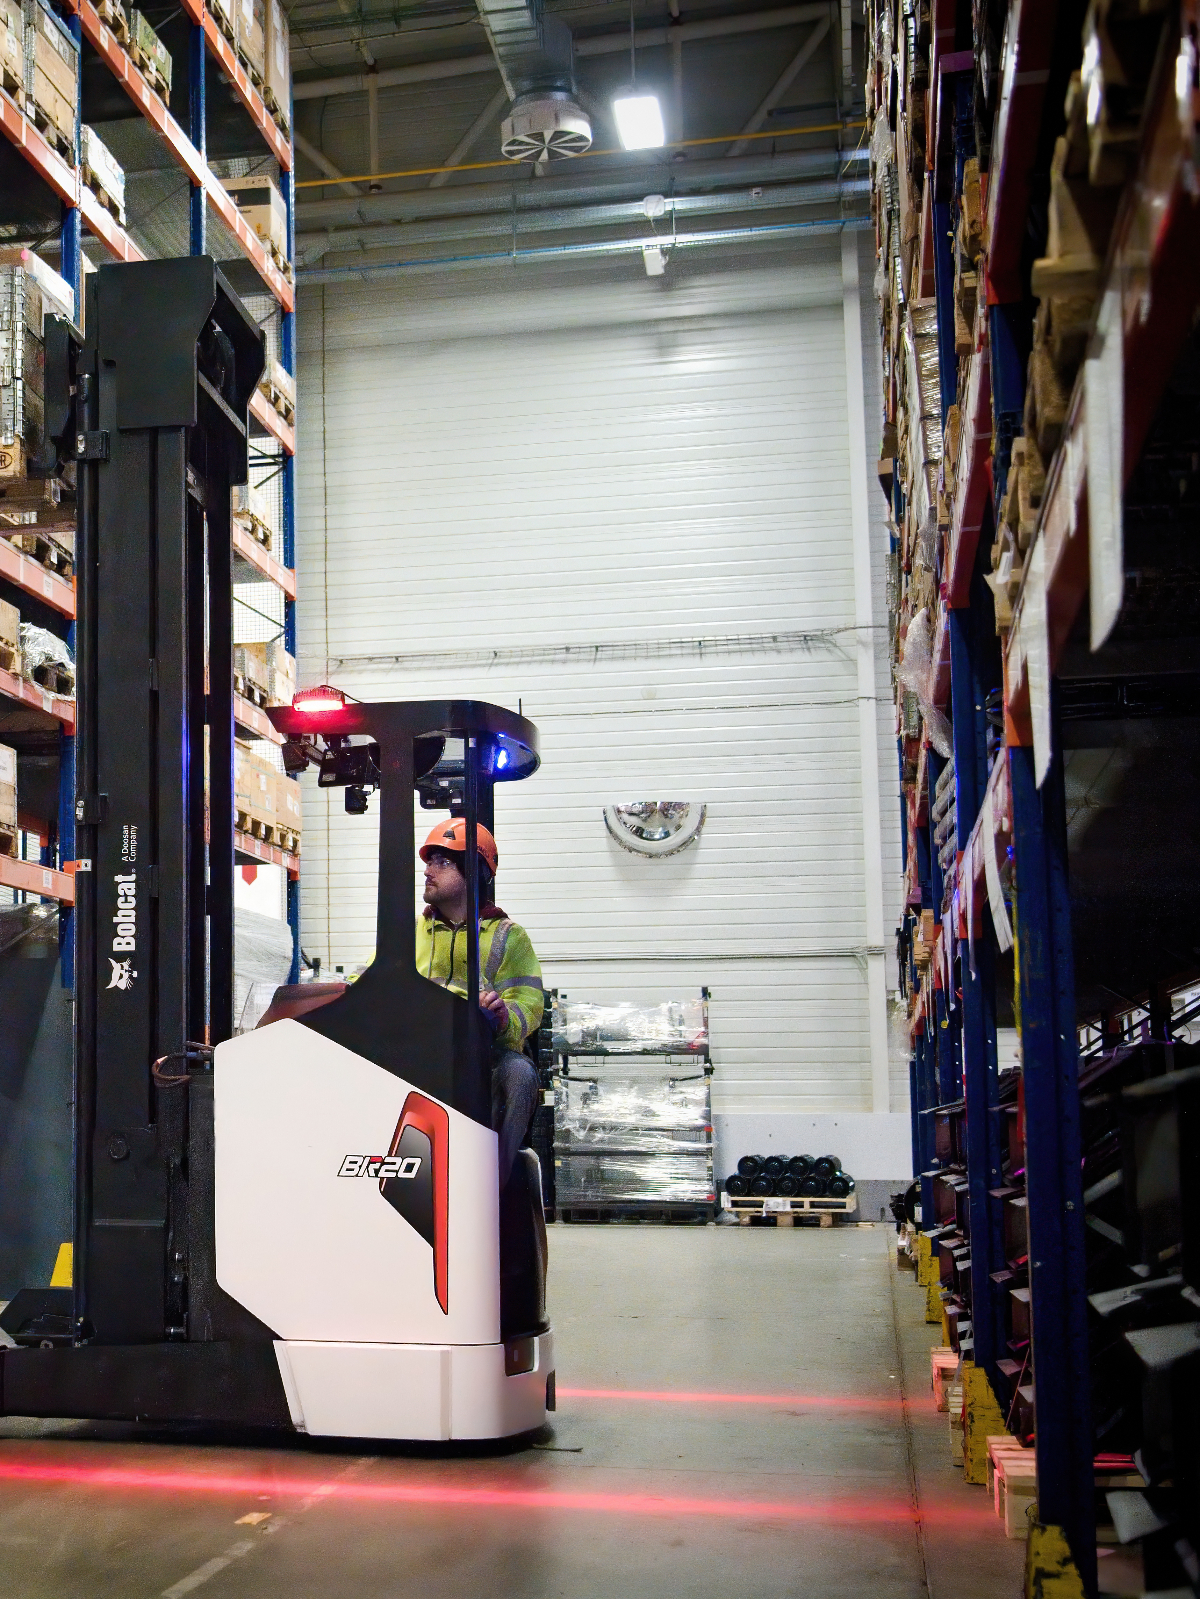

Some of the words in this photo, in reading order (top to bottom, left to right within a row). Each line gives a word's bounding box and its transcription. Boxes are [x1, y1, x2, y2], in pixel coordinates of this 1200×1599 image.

[121, 825, 129, 854] Doosan
[128, 824, 138, 862] Company
[112, 873, 137, 952] Bobcat
[337, 1154, 423, 1179] BR20
